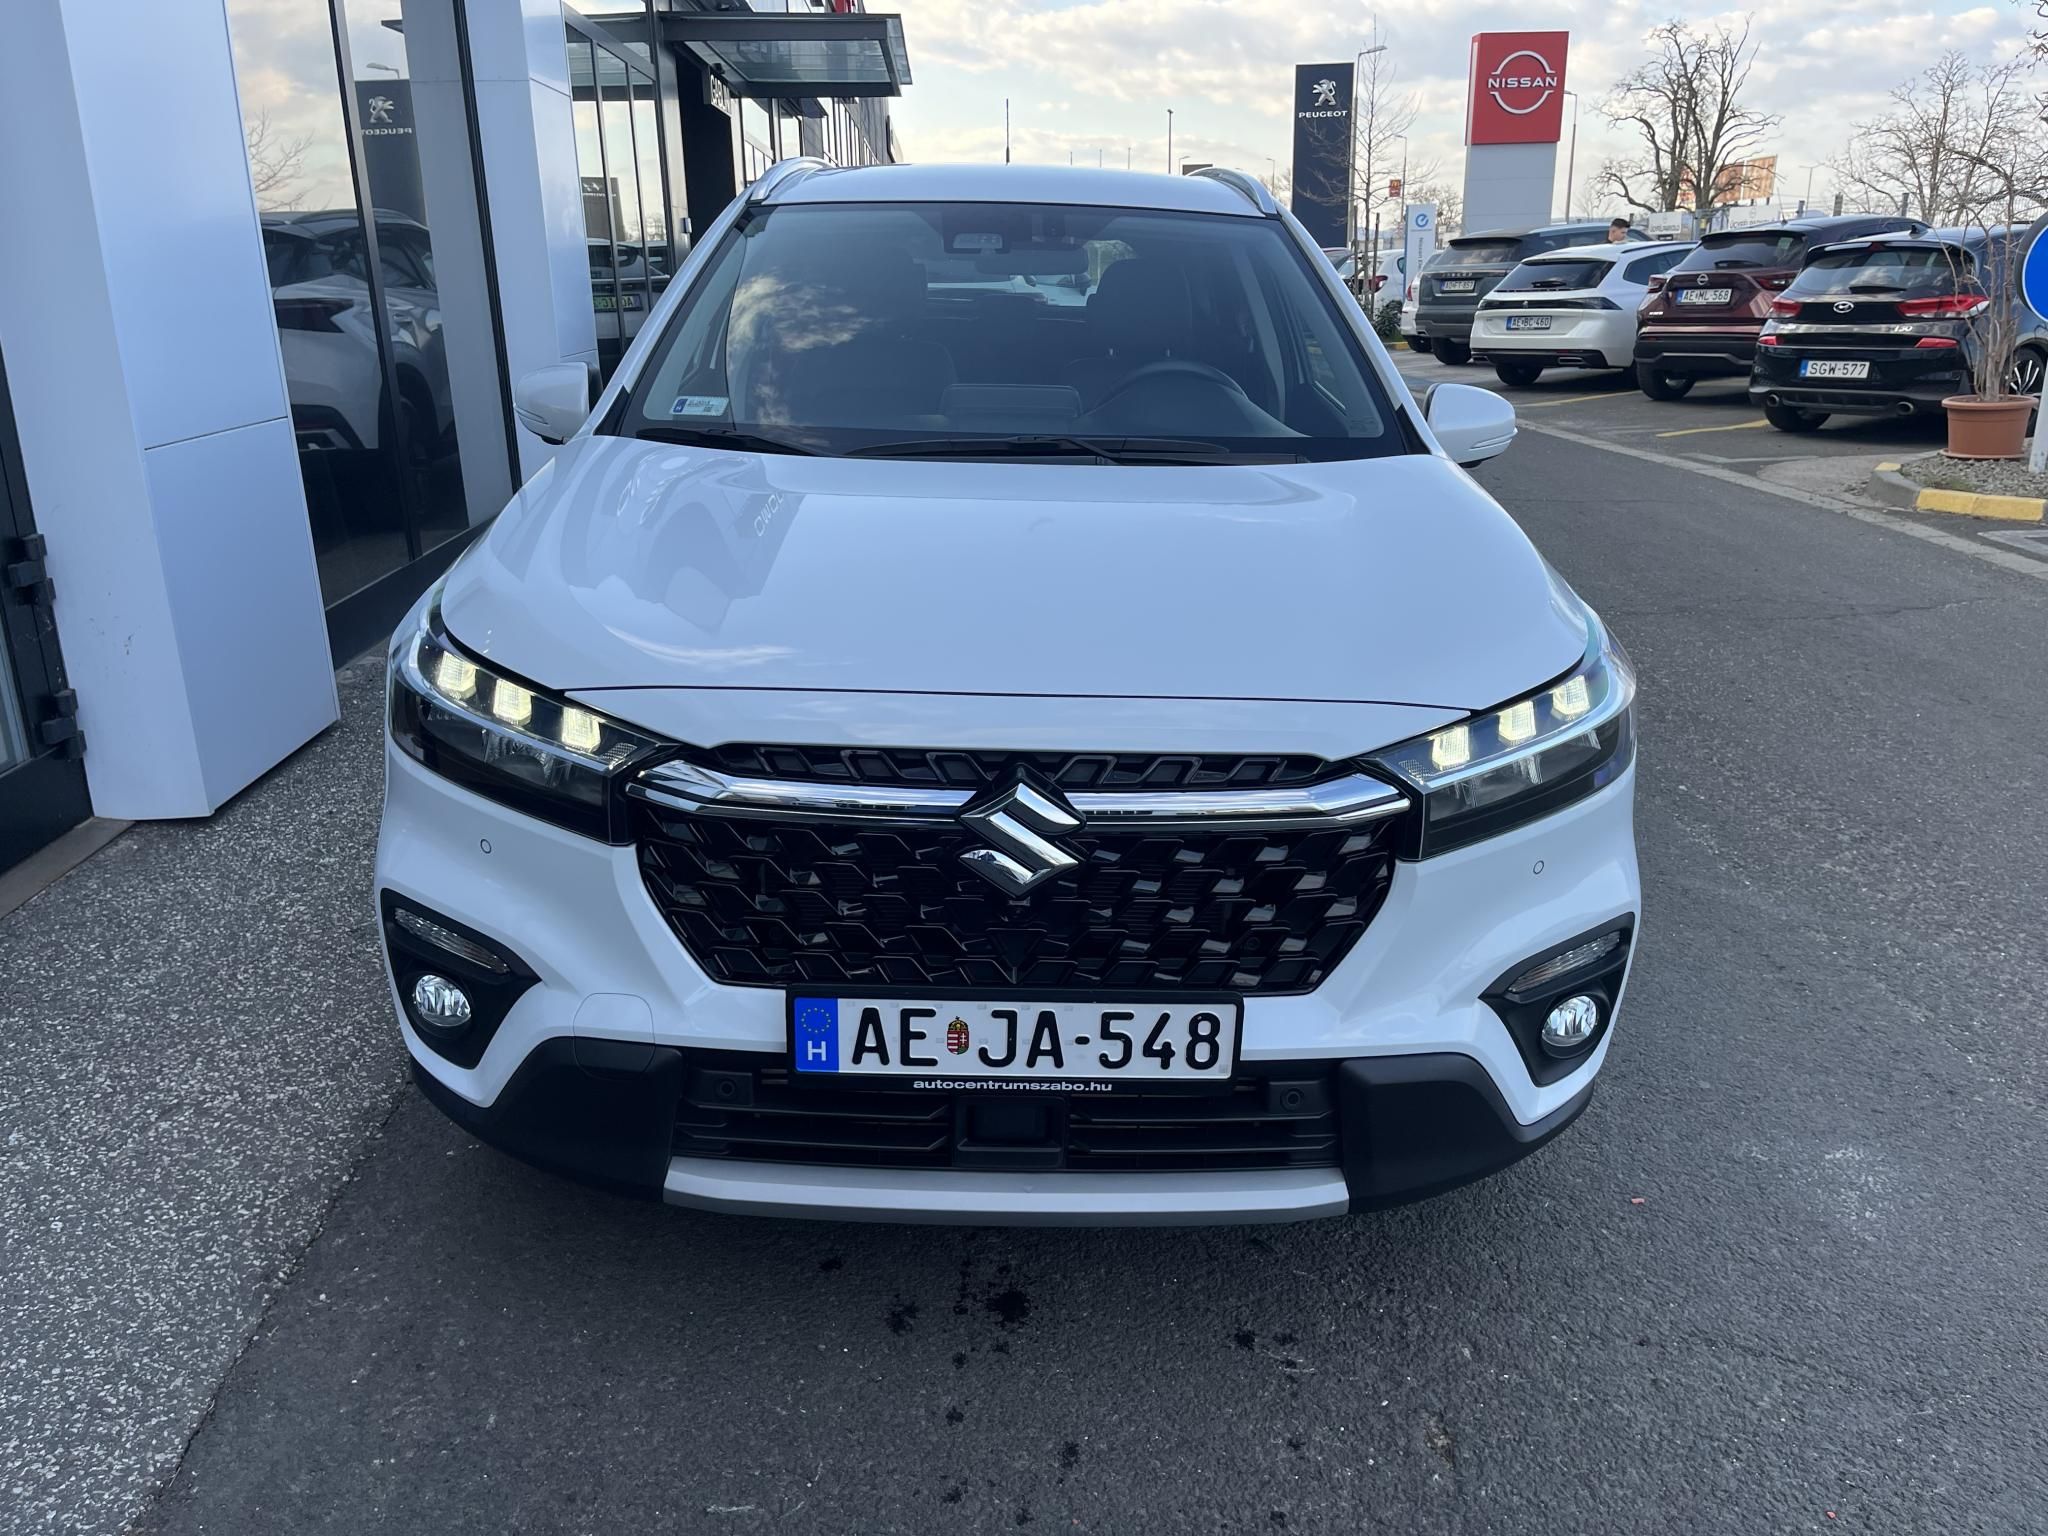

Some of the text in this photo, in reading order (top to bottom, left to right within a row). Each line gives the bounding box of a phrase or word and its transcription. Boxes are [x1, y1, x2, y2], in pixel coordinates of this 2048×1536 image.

[1488, 77, 1557, 88] NISSAN
[1298, 110, 1348, 118] PEUGEOT
[1809, 362, 1867, 376] SGW-577
[807, 1007, 1221, 1070] H AE JA-548
[913, 1079, 1113, 1092] autocentrumszabo.hu
